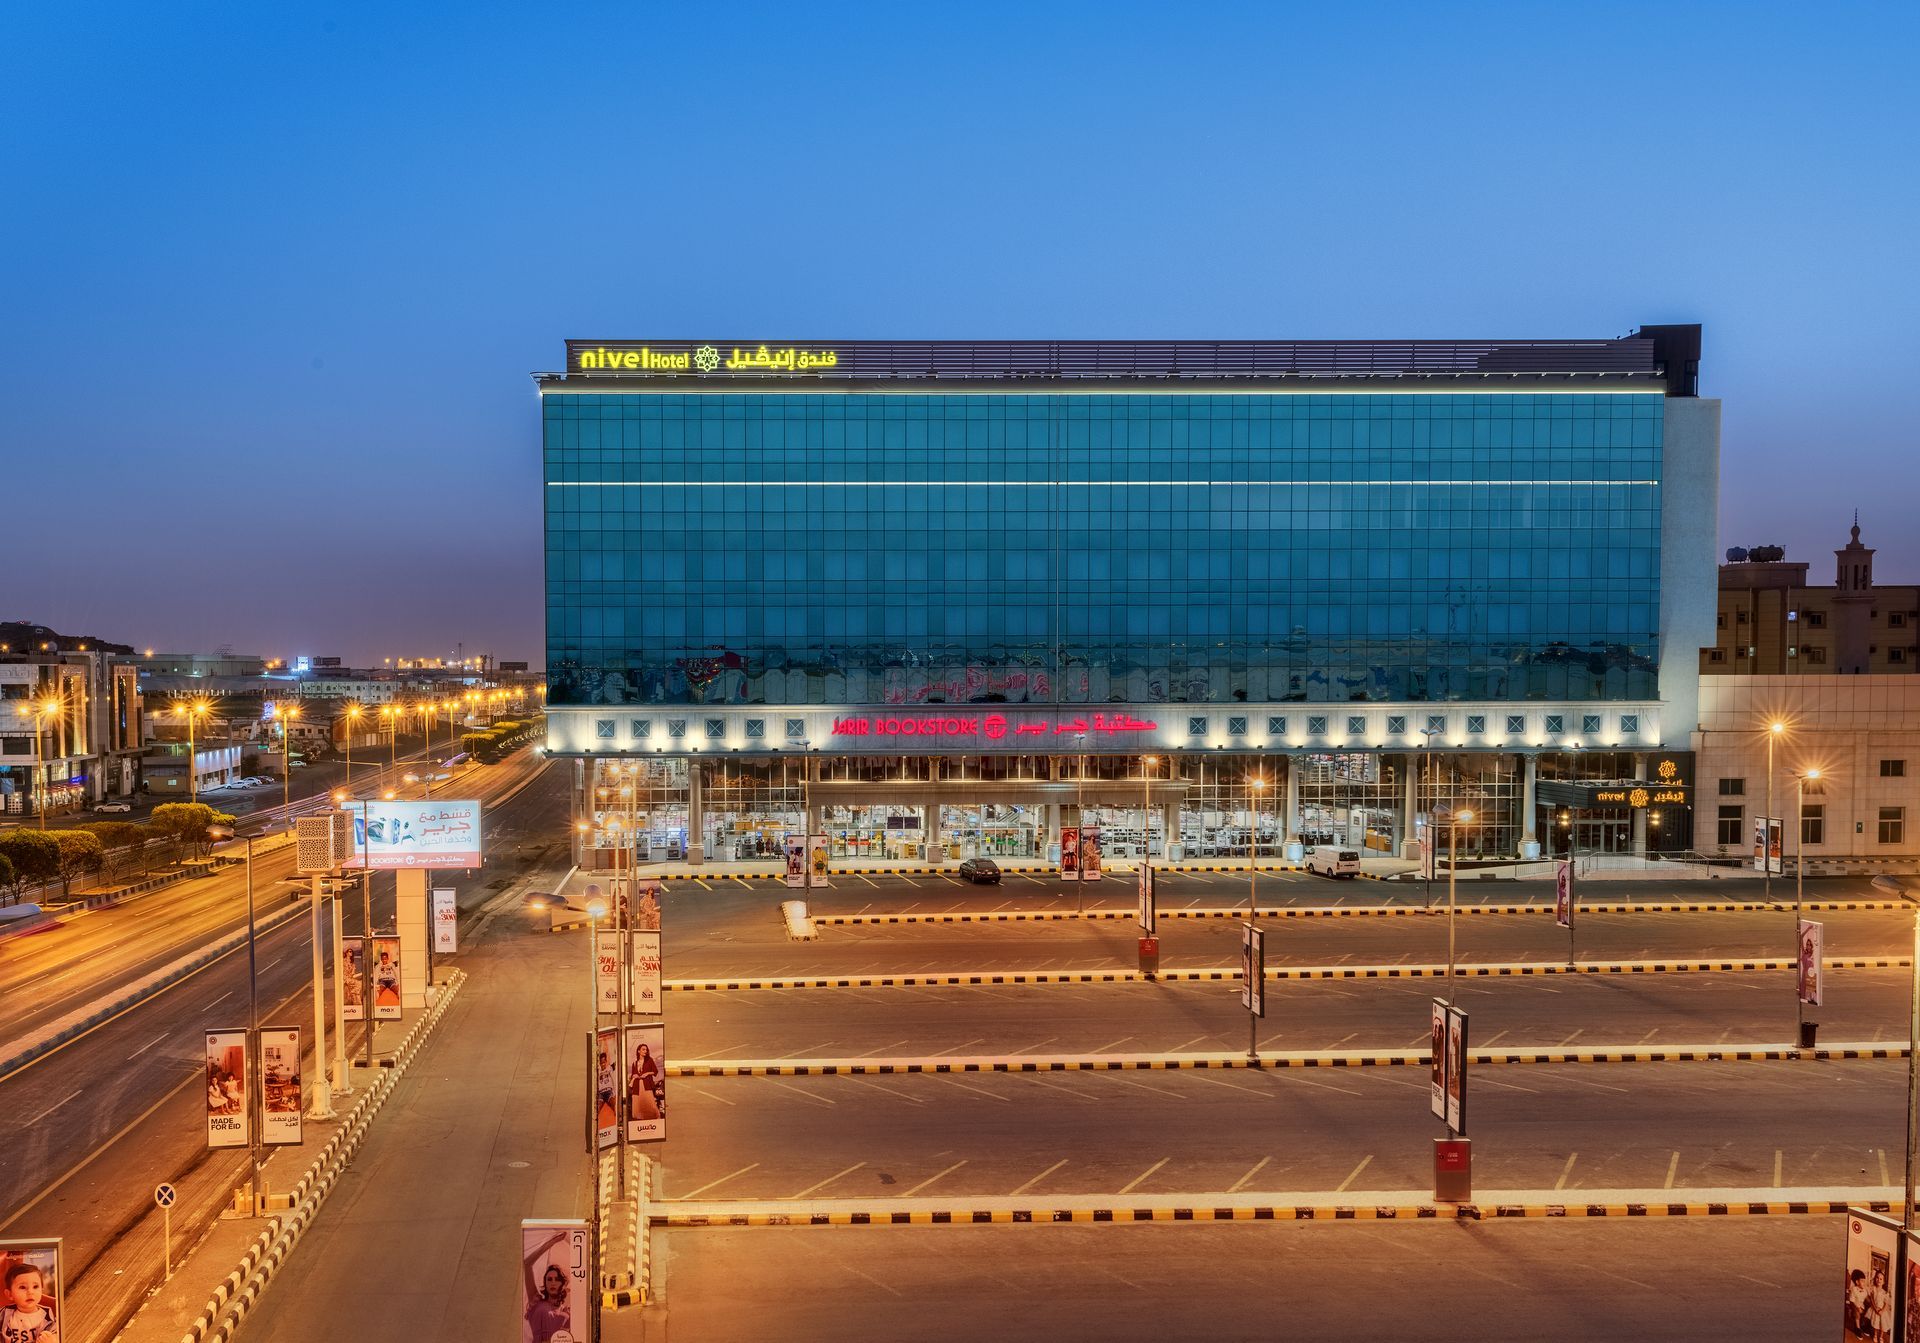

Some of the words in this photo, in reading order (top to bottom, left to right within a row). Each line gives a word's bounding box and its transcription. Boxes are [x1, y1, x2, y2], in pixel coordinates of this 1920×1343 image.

[581, 347, 649, 369] nivel
[650, 352, 689, 369] Hotel
[797, 351, 837, 369] فندق
[832, 717, 869, 736] JARIR
[876, 717, 978, 736] BOOKSTORE
[1094, 713, 1157, 735] مكتبة
[1597, 791, 1625, 801] nivel
[419, 812, 436, 823] مع
[420, 821, 471, 836] جرير
[211, 1117, 234, 1125] MADE
[211, 1123, 227, 1131] FOR
[228, 1122, 241, 1130] EID
